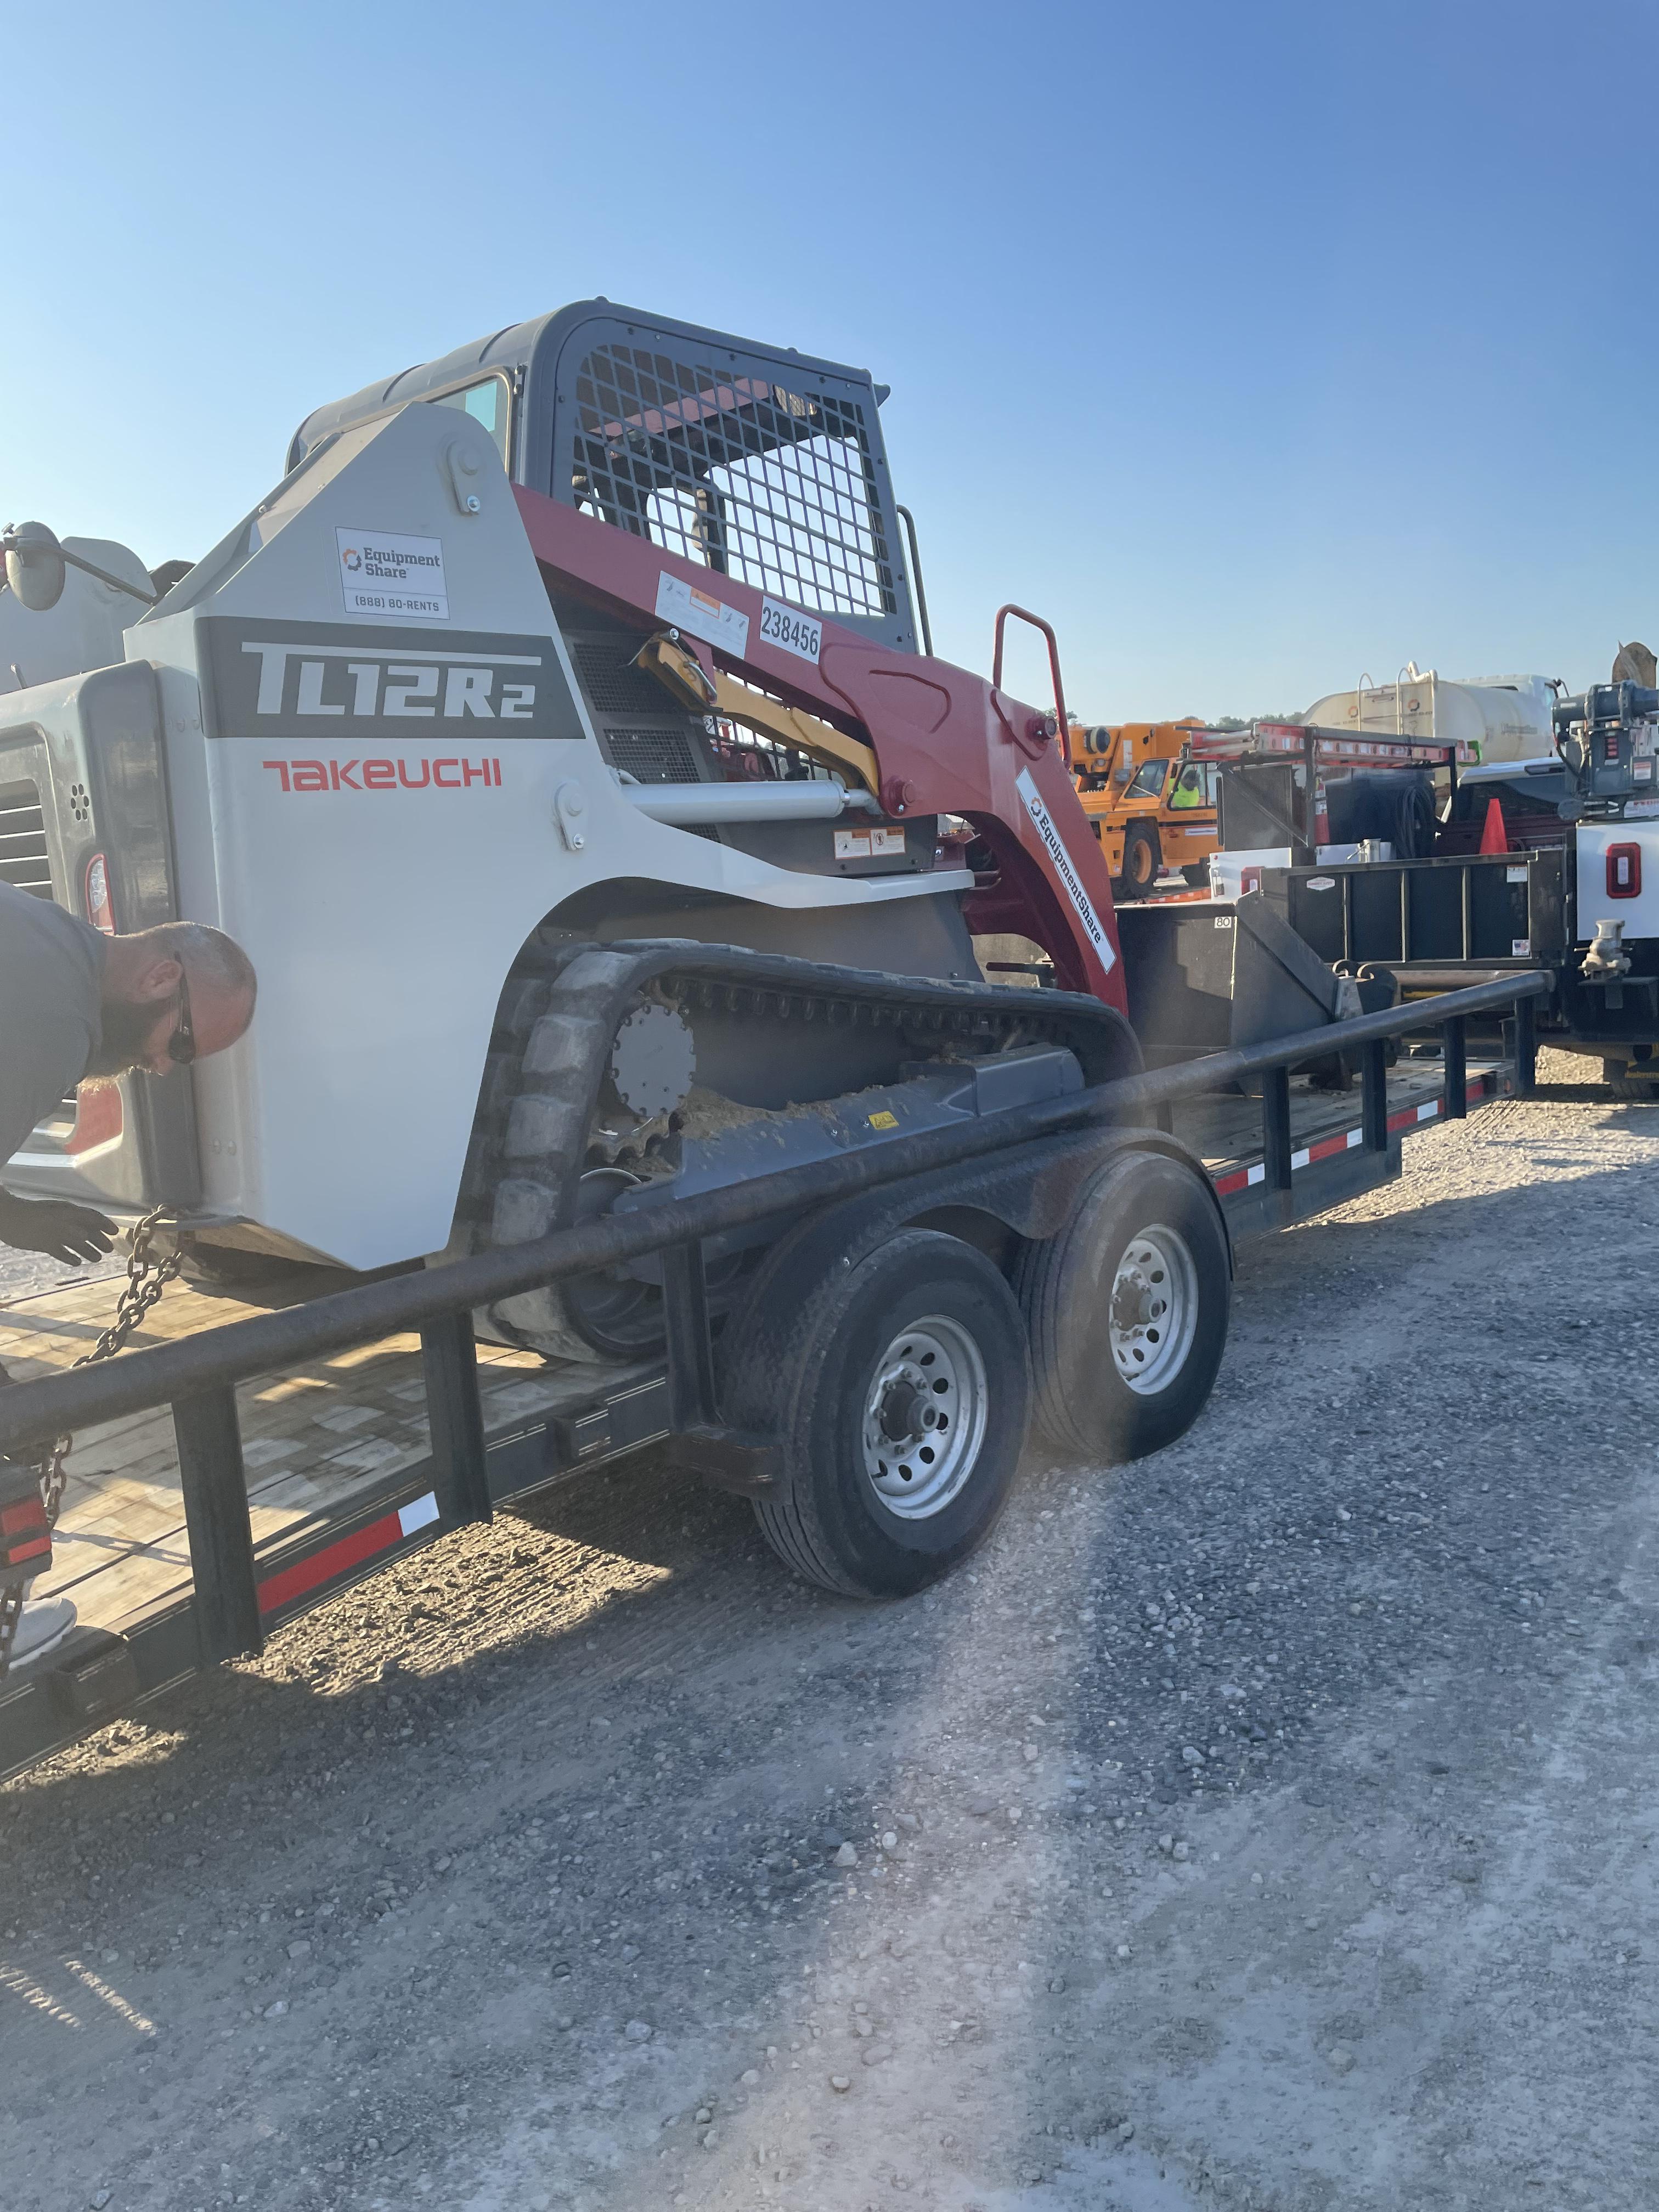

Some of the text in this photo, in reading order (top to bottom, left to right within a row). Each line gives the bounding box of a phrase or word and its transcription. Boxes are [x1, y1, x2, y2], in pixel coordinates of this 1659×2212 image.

[363, 547, 441, 567] Equipment
[365, 563, 407, 579] Share
[356, 595, 439, 611] (888) 80-RENTS
[761, 606, 819, 656] 238456
[1039, 814, 1102, 944] EquipmentShare
[1217, 917, 1230, 927] 80
